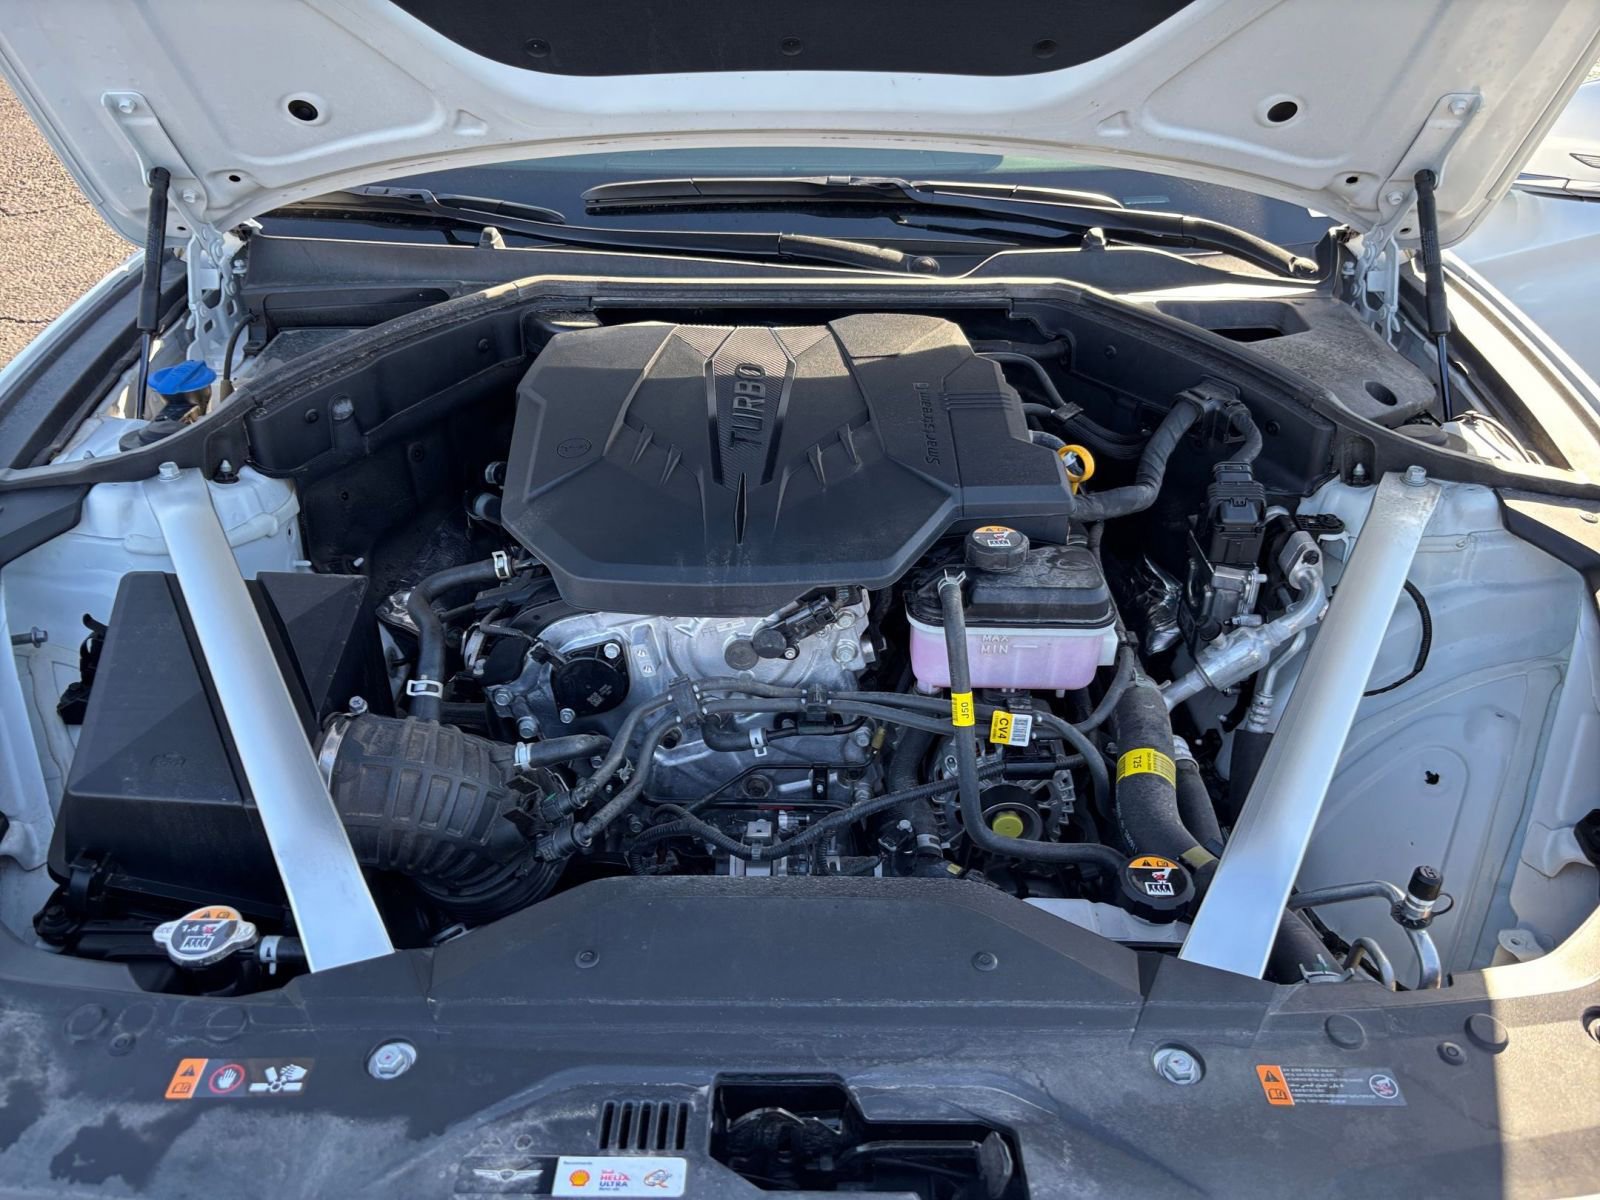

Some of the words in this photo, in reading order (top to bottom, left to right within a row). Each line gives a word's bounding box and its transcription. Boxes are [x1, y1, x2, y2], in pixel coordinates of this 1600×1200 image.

[729, 362, 766, 449] TURBO
[919, 391, 940, 465] Smartstream
[982, 633, 1009, 642] MAX
[980, 644, 1009, 655] MIN
[960, 702, 969, 719] J50
[997, 718, 1009, 739] CV4
[1132, 755, 1142, 769] T25
